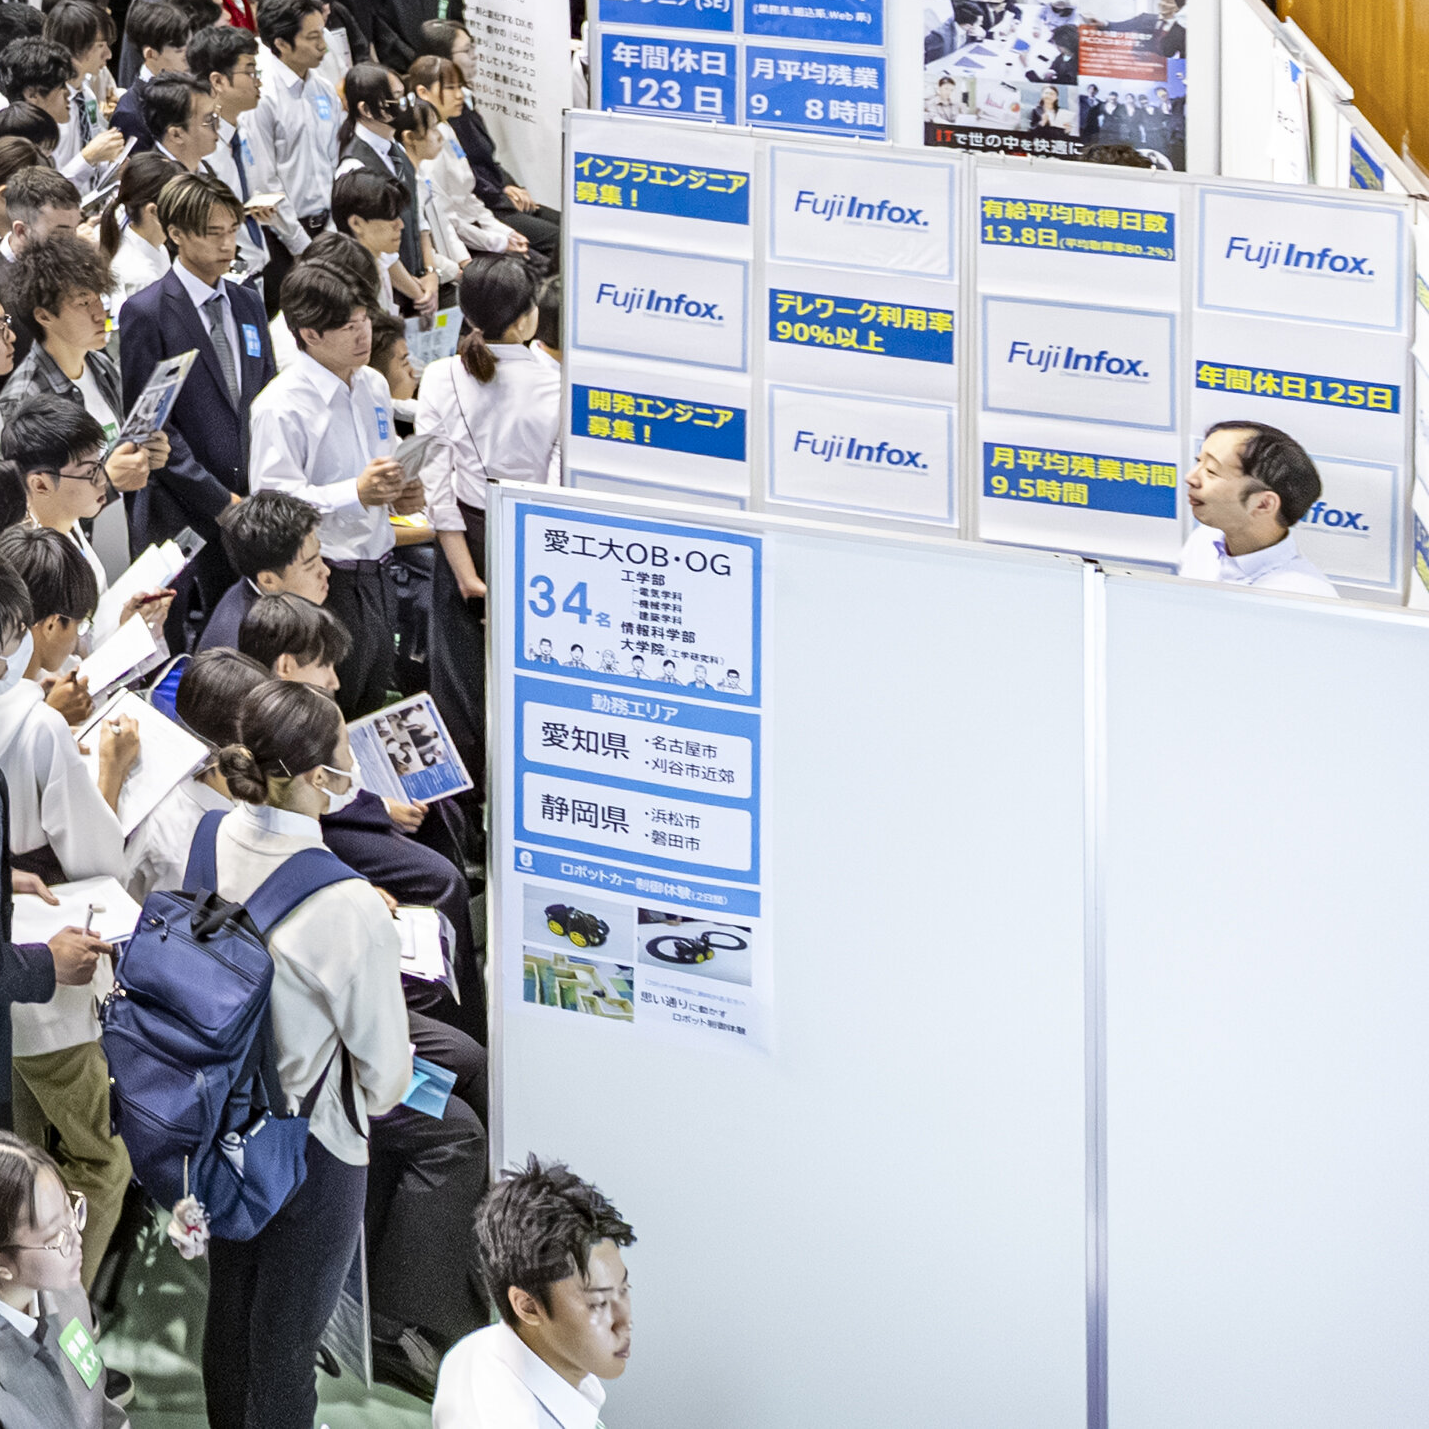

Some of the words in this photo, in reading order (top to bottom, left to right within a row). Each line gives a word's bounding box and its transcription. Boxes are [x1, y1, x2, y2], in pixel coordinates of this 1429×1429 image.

[613, 43, 728, 78] 年間休日
[752, 57, 880, 90] 月平均残業
[576, 157, 748, 195] インフラエンジニア
[982, 199, 1168, 235] 有給平均取得日数
[777, 294, 955, 333] テレワーク利用率
[776, 321, 885, 354] 90%以上
[1196, 365, 1393, 411] 年間休日125日
[588, 390, 734, 429] 開発エンジニア
[992, 449, 1178, 489] 月平均残業時間
[991, 475, 1089, 507] 9.5時間
[544, 528, 732, 577] 愛工大OB・OG
[621, 570, 665, 586] 工学部
[621, 621, 695, 644] 情報科学部
[540, 722, 631, 760] 愛知県
[540, 794, 630, 835] 静岡県
